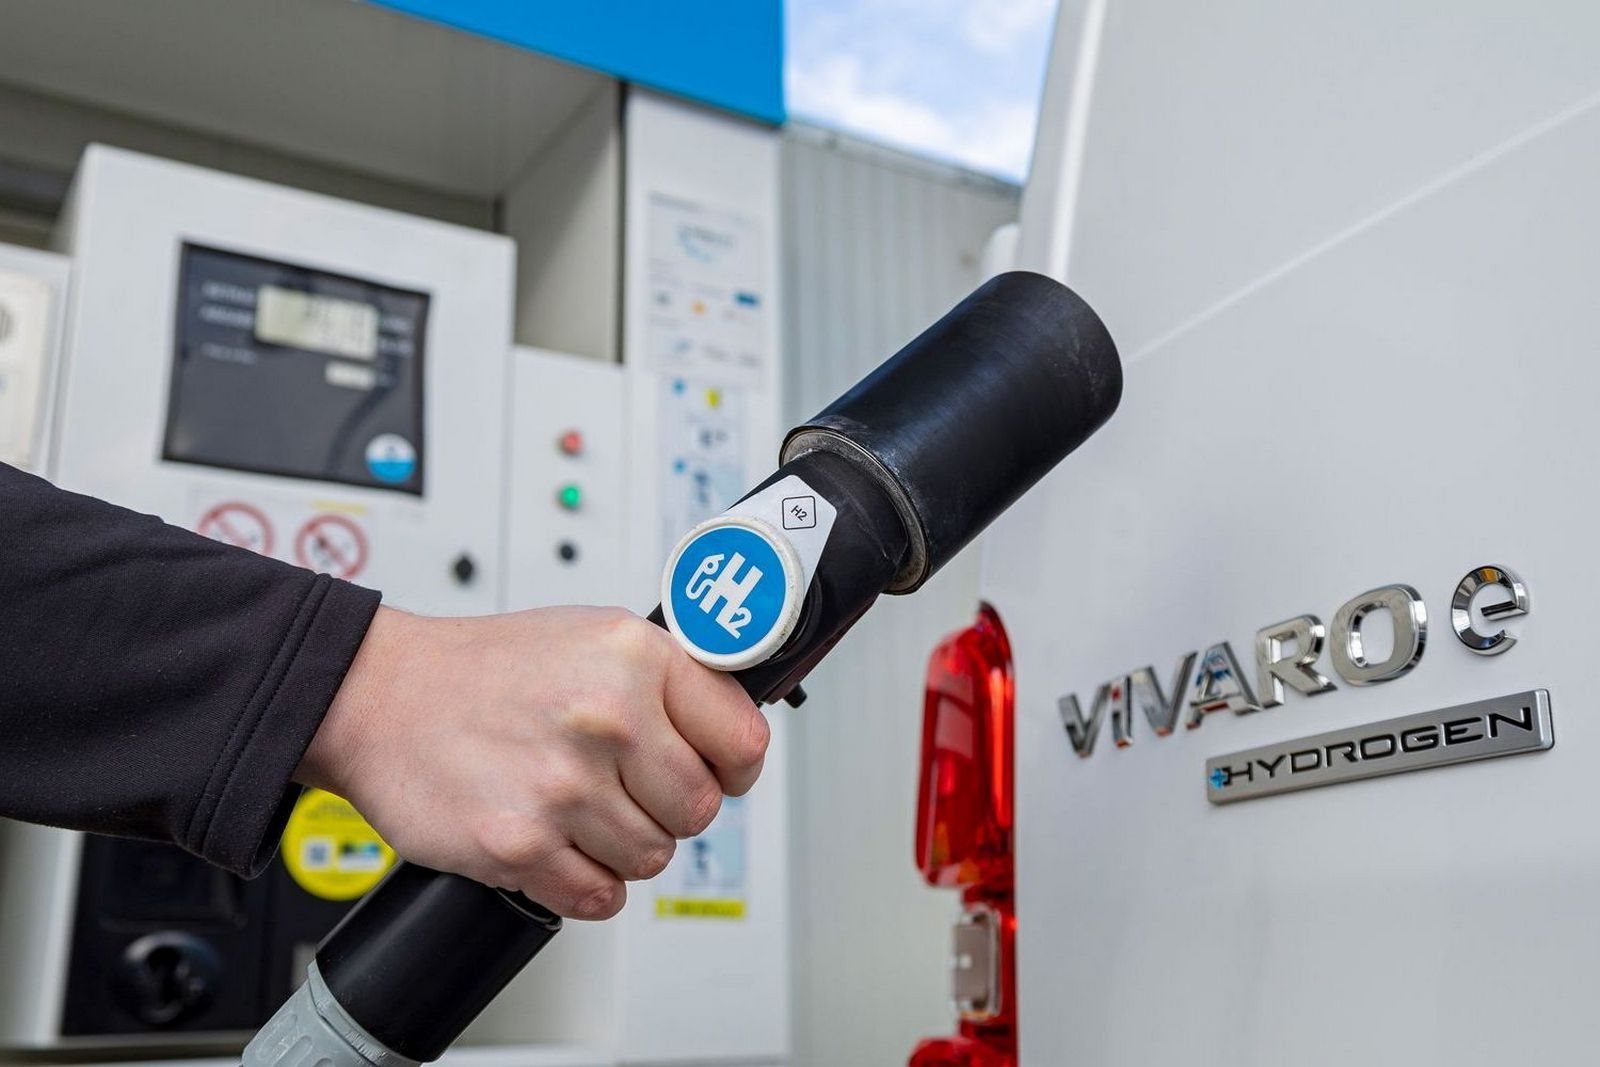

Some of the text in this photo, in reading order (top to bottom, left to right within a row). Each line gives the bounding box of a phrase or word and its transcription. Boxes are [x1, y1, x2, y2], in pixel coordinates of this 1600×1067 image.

[790, 505, 808, 521] H2
[699, 552, 763, 640] H2
[1057, 565, 1530, 758] VIVARO e
[1222, 706, 1534, 786] HYDROGEN
